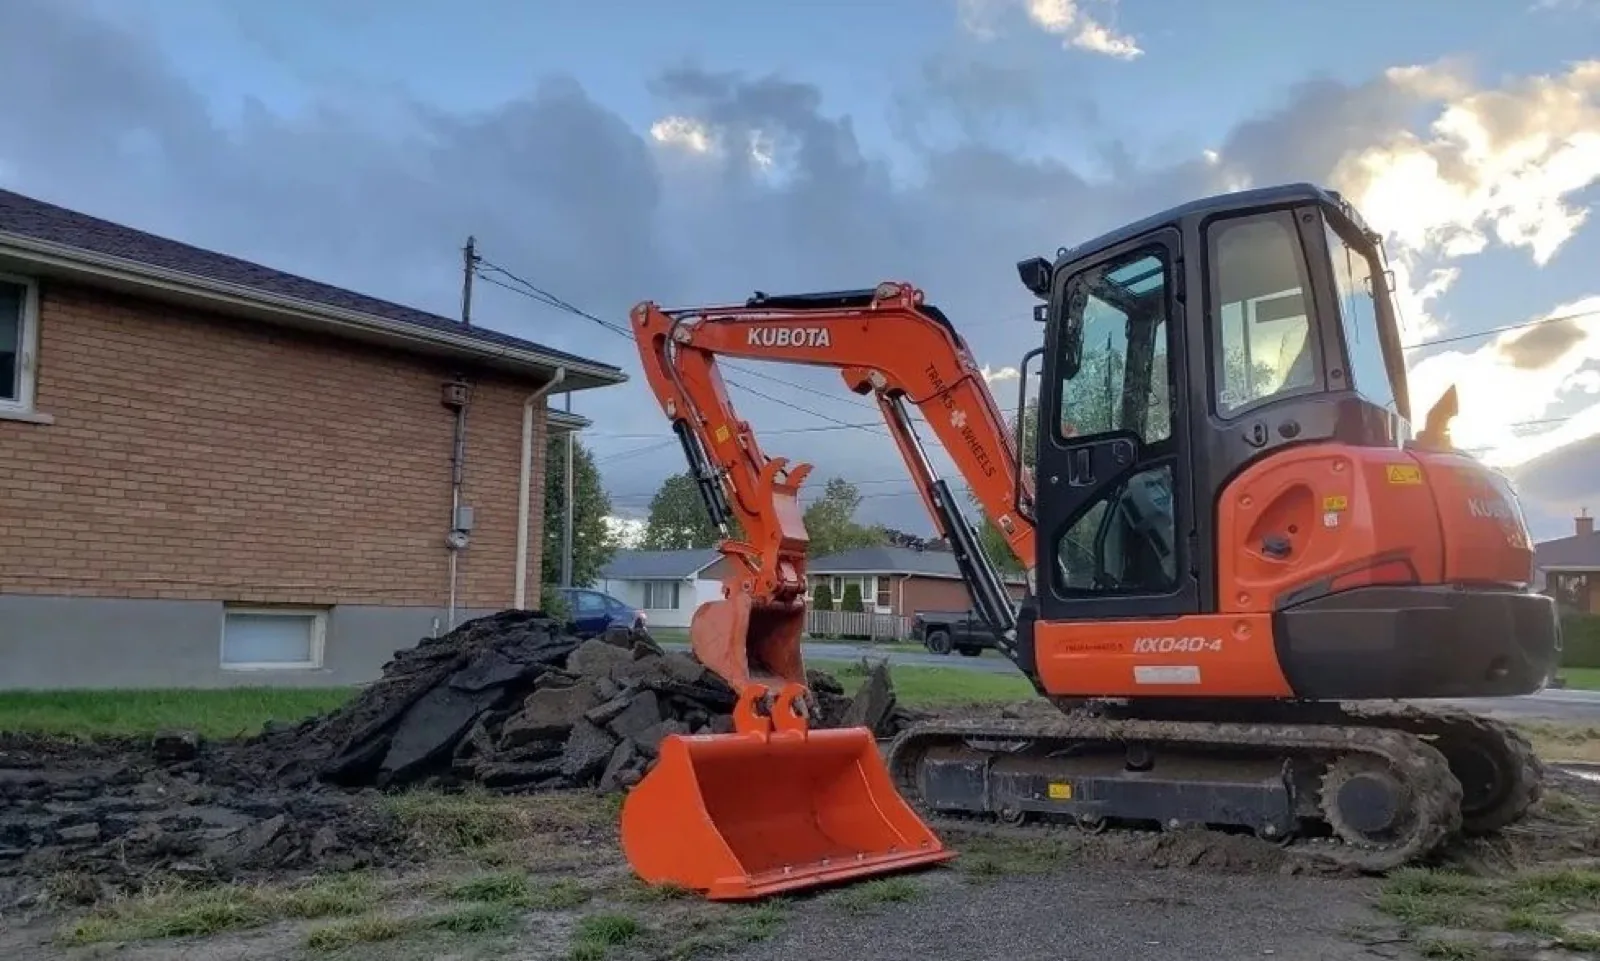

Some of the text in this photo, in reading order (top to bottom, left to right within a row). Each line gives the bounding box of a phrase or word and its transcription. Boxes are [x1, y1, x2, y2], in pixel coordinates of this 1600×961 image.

[747, 327, 831, 347] KUBOTA
[961, 426, 997, 478] WHEELS
[1132, 637, 1223, 653] KX040-4
